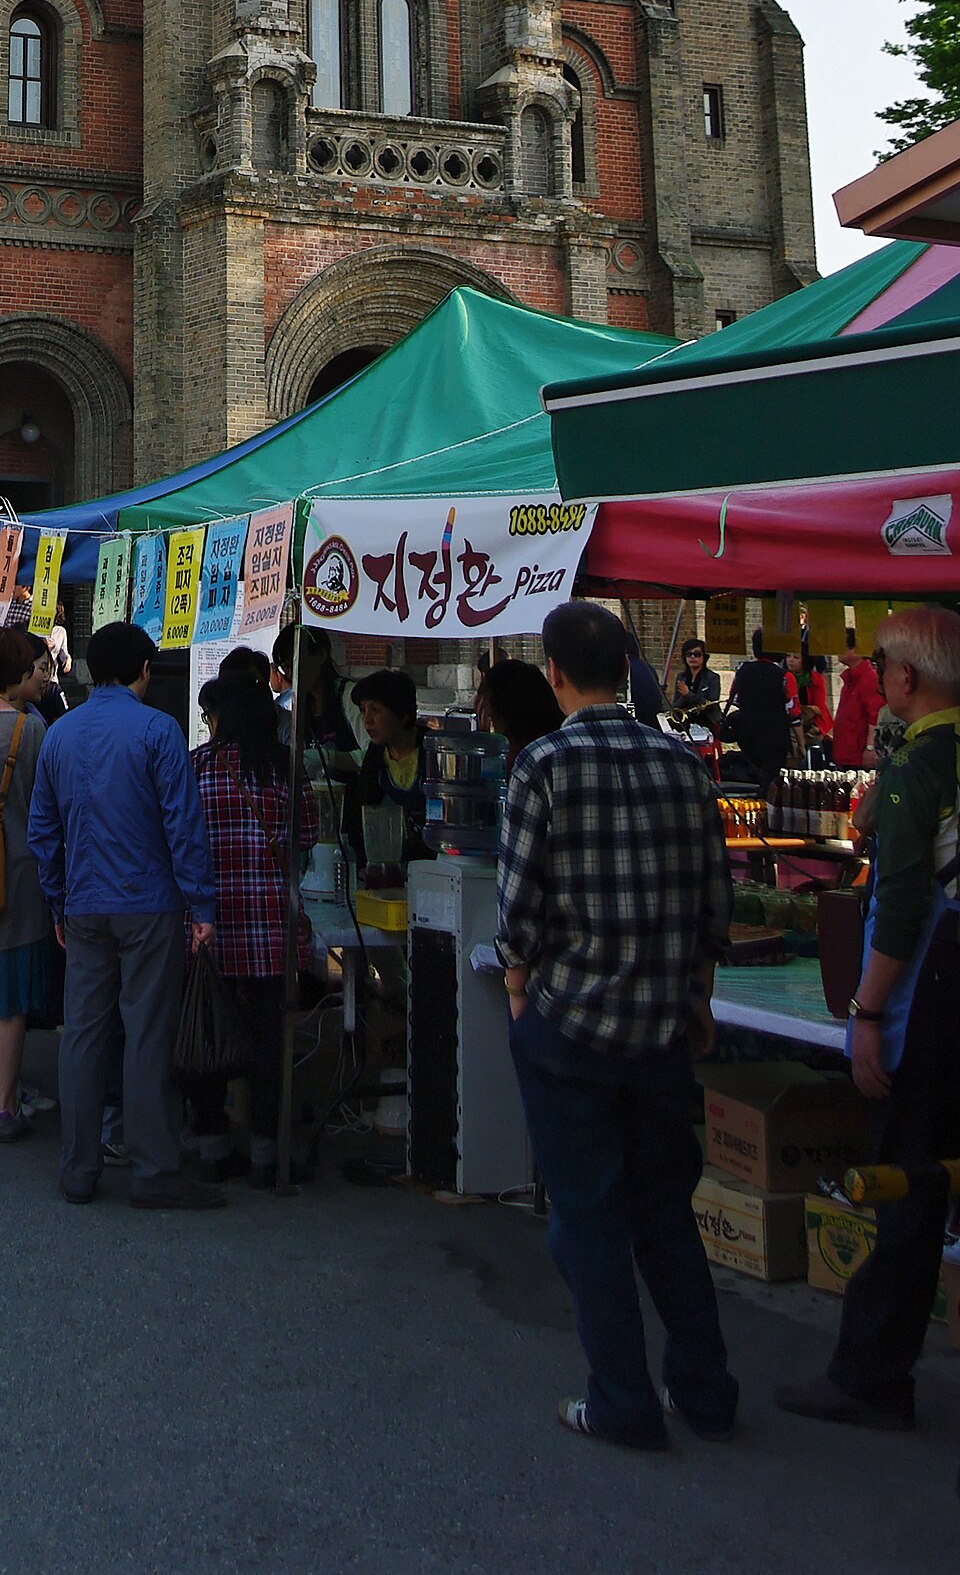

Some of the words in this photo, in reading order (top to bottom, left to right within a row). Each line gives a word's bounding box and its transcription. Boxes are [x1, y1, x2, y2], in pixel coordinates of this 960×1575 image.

[253, 520, 286, 548] 지정환
[885, 508, 943, 544] CARAVAN
[177, 544, 194, 566] 조각
[210, 534, 240, 559] 지정환
[251, 545, 282, 575] 임실치
[41, 545, 54, 607] 참기름
[174, 568, 192, 590] 피자
[361, 506, 513, 630] 지정환
[512, 564, 566, 600] Pizza
[249, 571, 281, 600] 즈피자
[170, 593, 192, 616] (2쪽)
